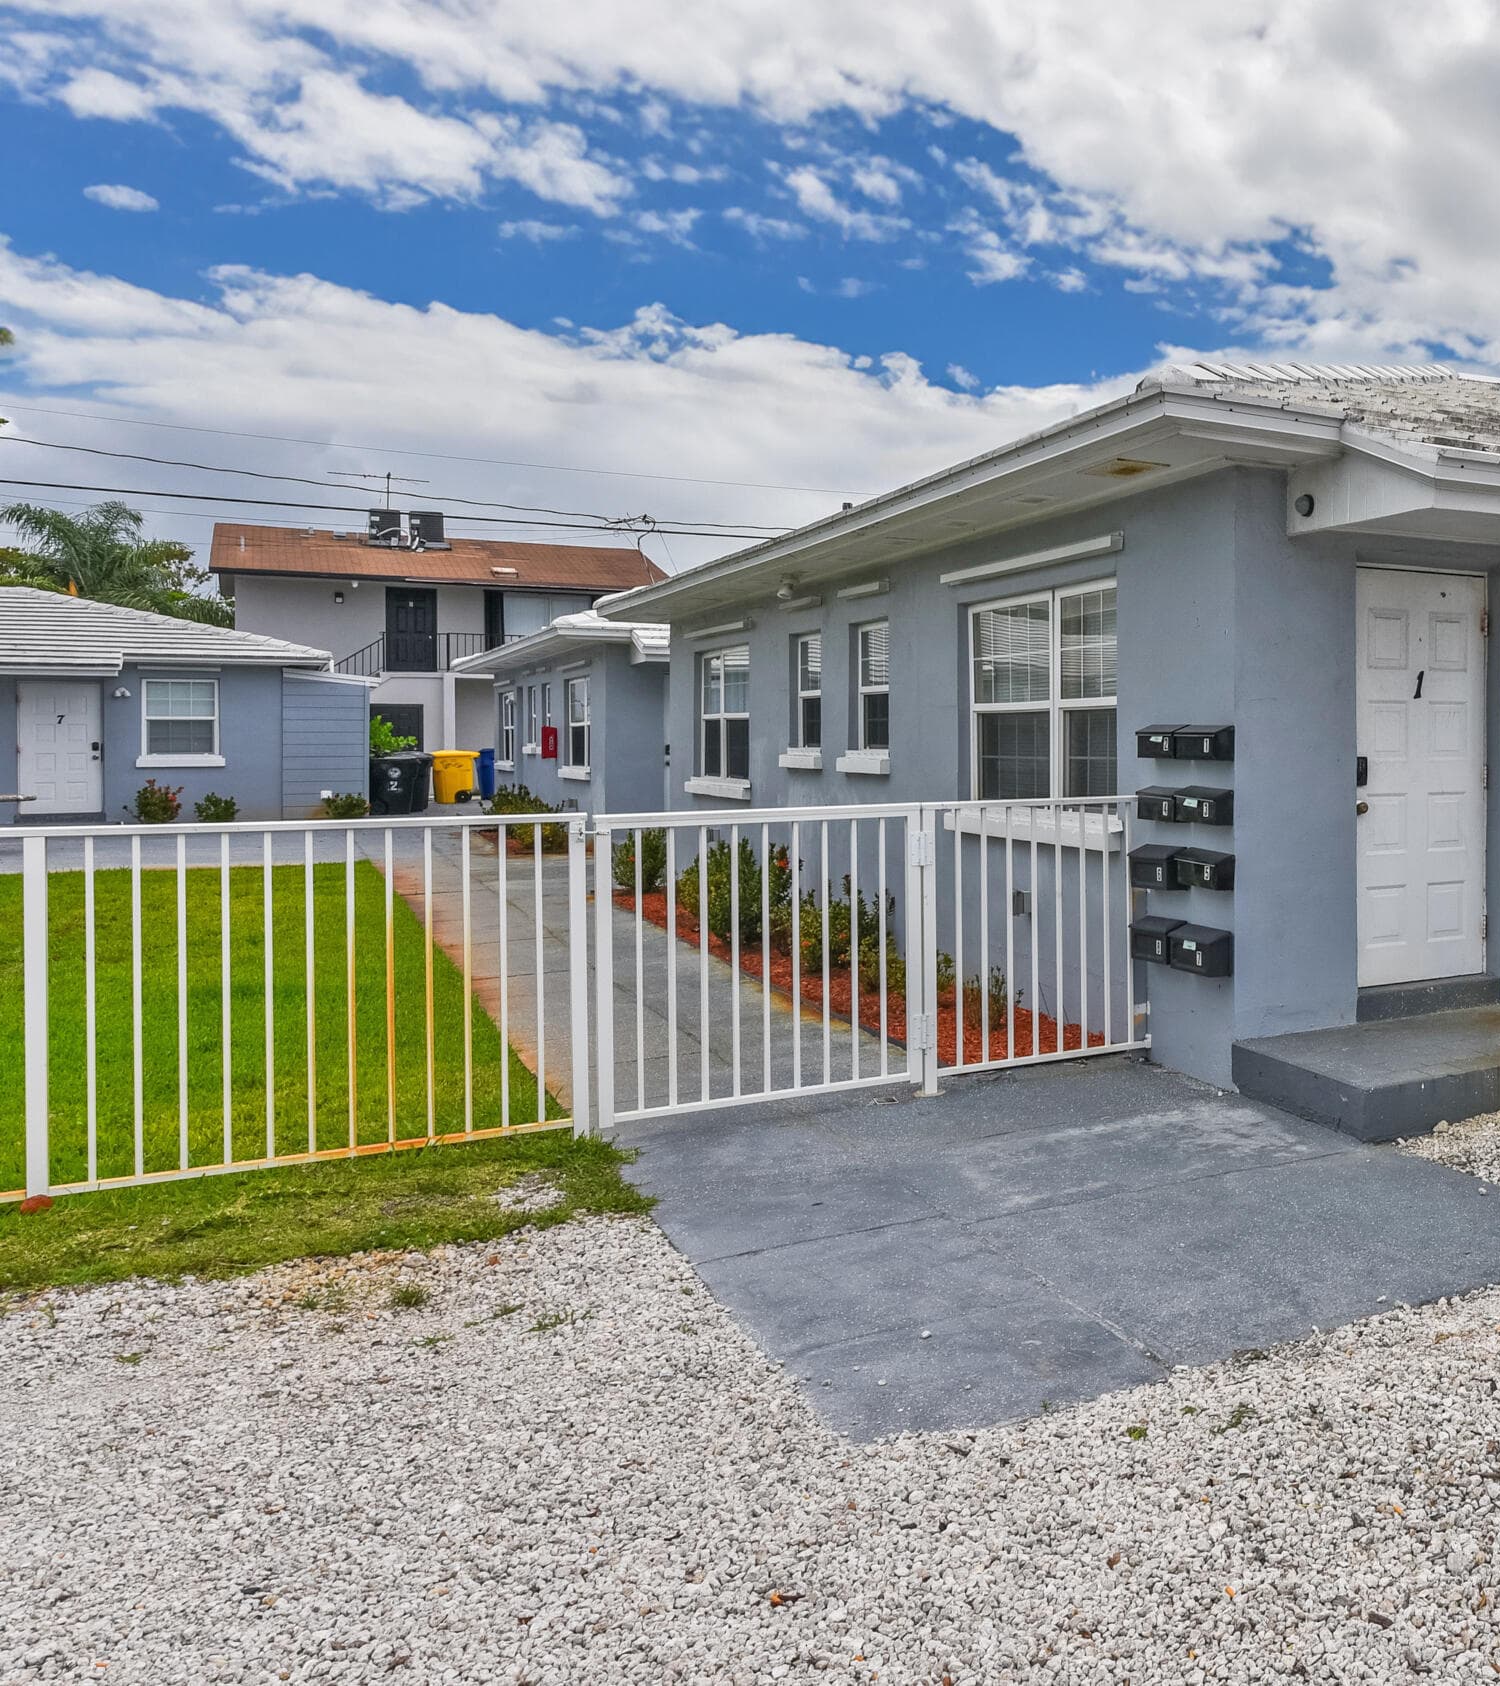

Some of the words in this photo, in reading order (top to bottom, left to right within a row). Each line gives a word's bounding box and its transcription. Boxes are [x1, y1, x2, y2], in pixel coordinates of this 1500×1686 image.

[1413, 670, 1424, 699] 1
[56, 714, 65, 725] 7
[389, 781, 398, 791] 2
